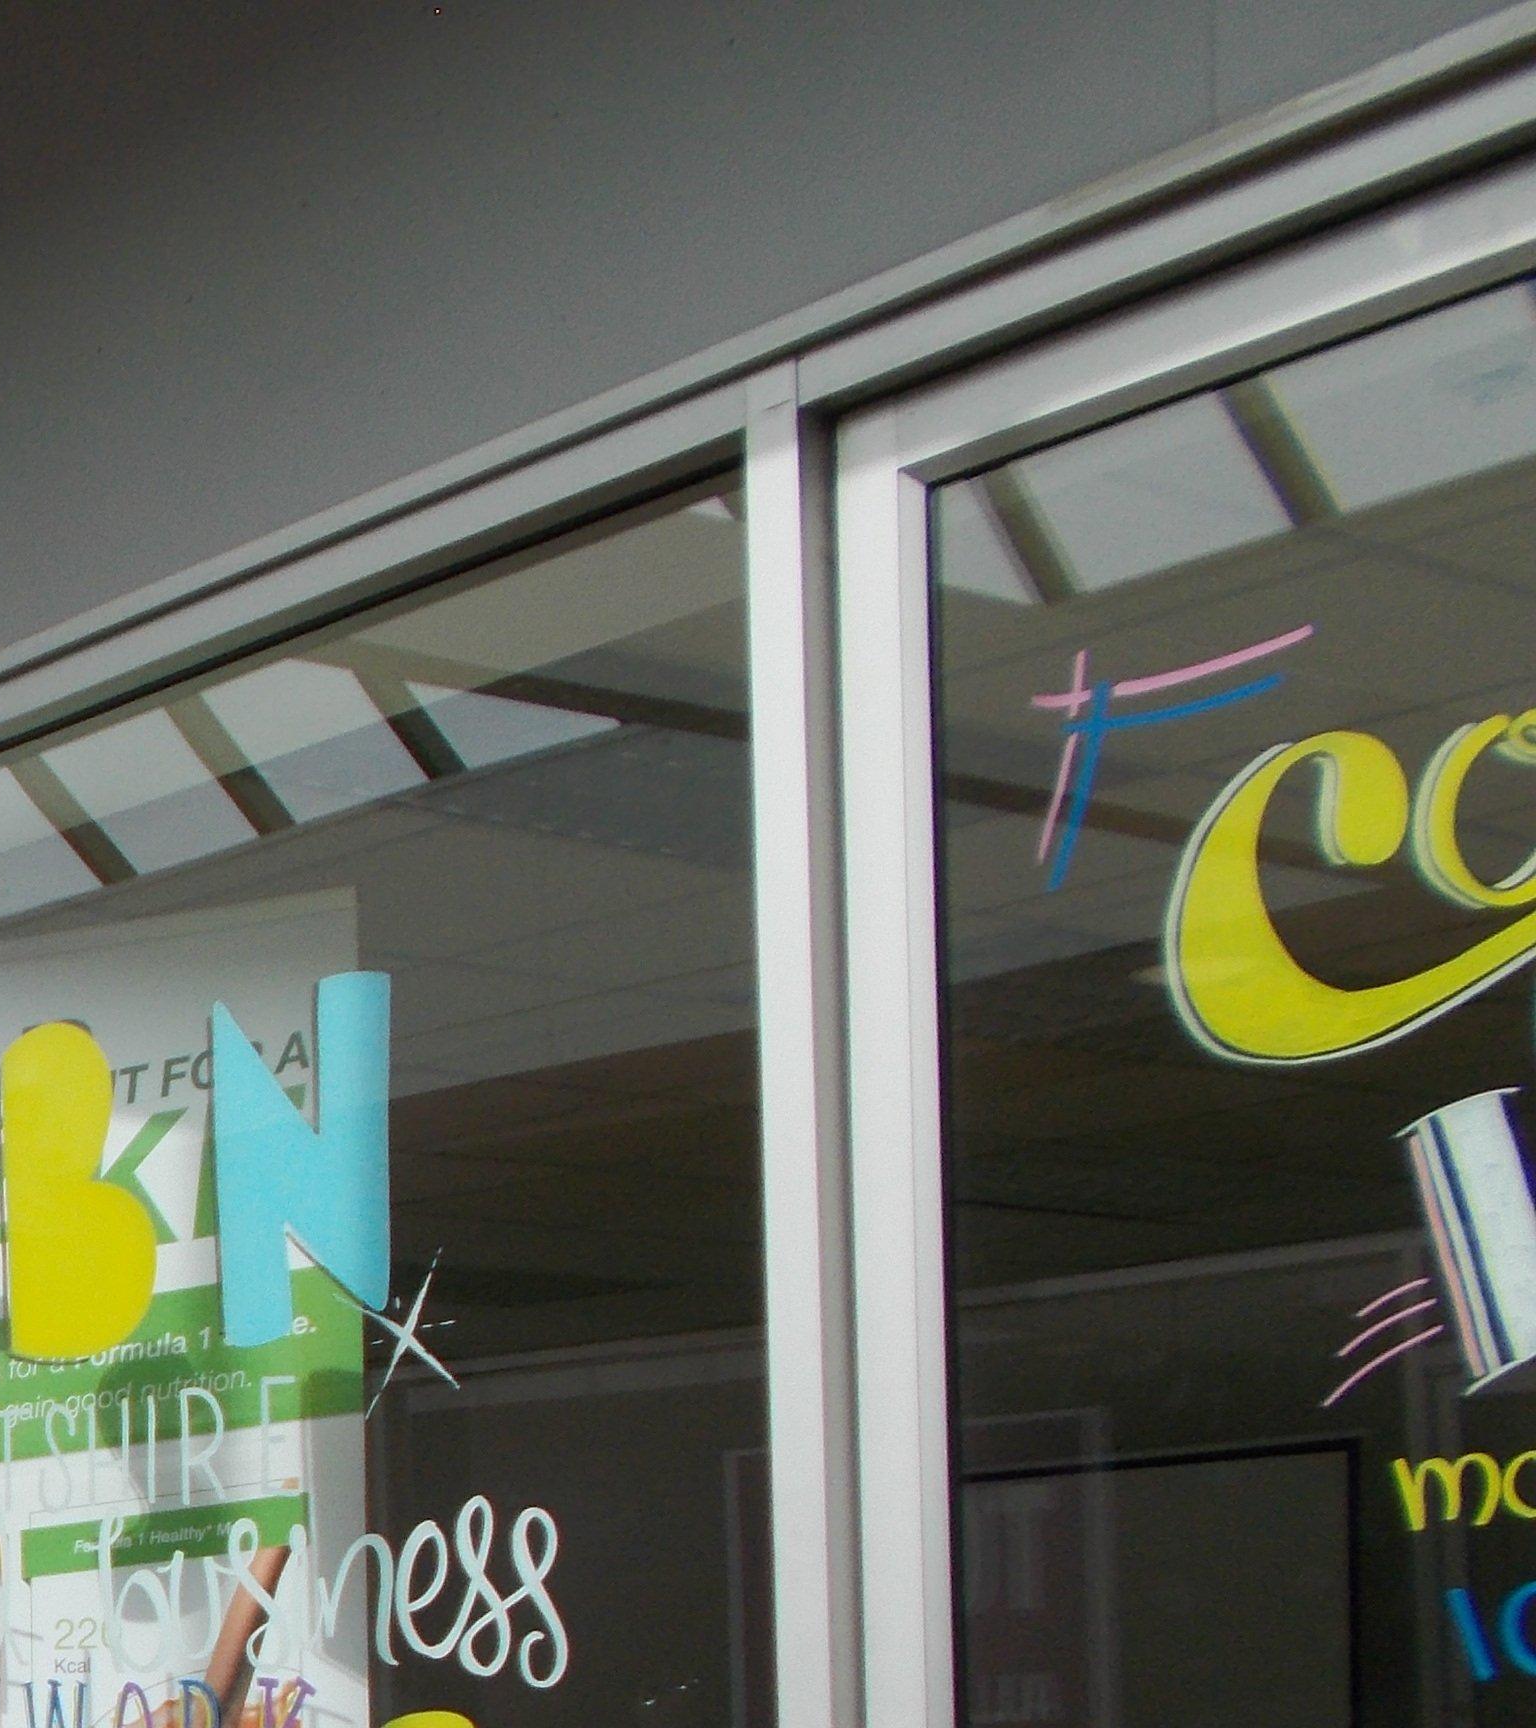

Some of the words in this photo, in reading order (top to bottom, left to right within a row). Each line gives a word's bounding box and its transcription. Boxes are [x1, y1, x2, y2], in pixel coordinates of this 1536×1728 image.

[160, 1040, 264, 1099] FO
[274, 1030, 310, 1075] A
[199, 1326, 212, 1349] 1
[5, 1395, 59, 1428] gain
[65, 1381, 132, 1416] good
[139, 1368, 253, 1402] nutrition.
[88, 1493, 570, 1689] business
[54, 1657, 92, 1674] Kcal
